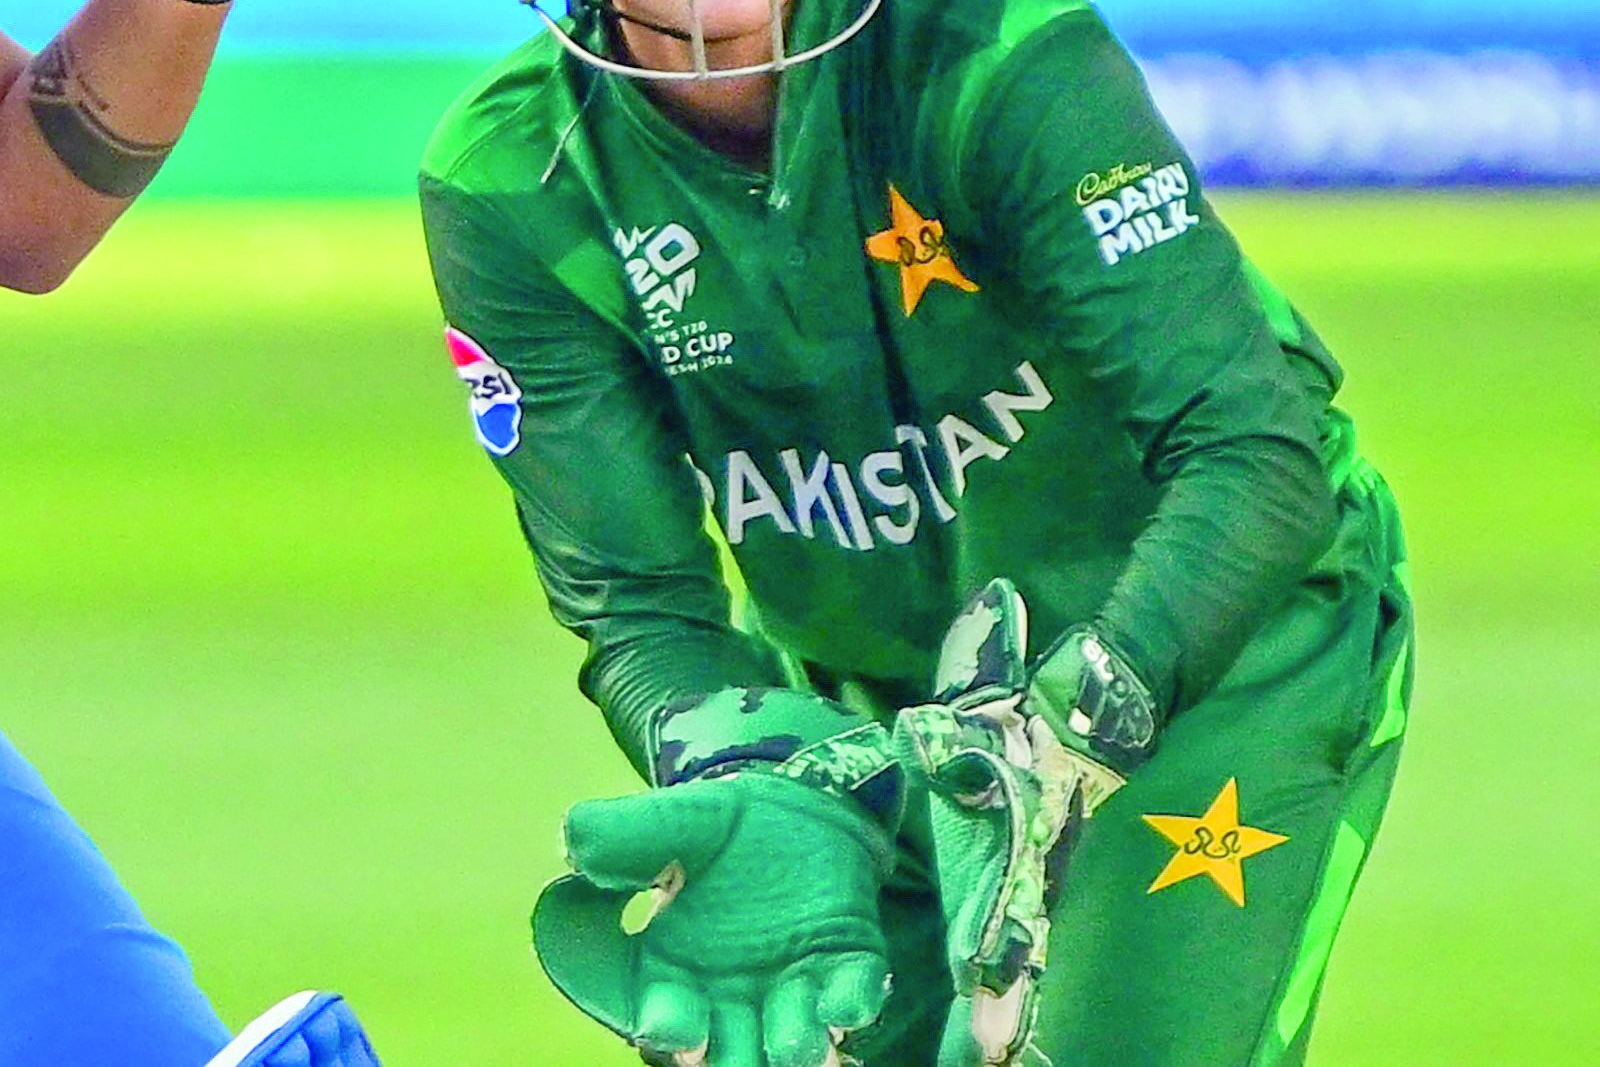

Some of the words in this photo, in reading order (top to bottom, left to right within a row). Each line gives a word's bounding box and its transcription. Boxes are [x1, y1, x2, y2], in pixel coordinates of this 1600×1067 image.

[1082, 162, 1189, 236] DAIRY
[1100, 198, 1200, 266] MILK
[686, 331, 734, 358] CUP
